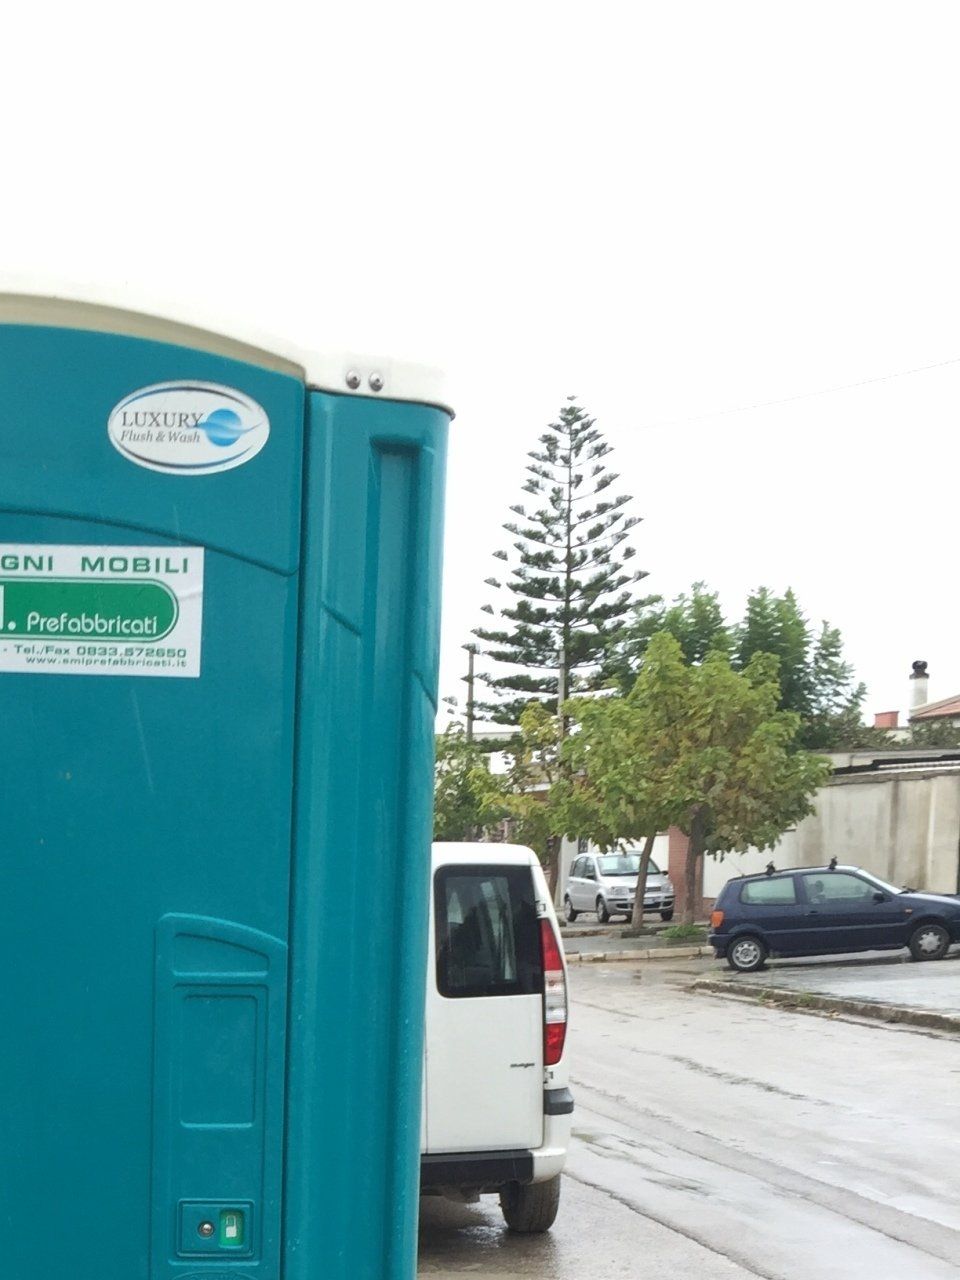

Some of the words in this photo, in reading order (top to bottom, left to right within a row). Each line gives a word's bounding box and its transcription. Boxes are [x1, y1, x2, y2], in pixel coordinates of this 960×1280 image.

[122, 412, 203, 427] LUXURY
[121, 431, 152, 442] Flush
[155, 431, 165, 442] &
[169, 432, 200, 442] Wash
[81, 556, 189, 574] MOBILI
[27, 612, 158, 634] Prefabbricati
[14, 645, 70, 655] Tel./Fax
